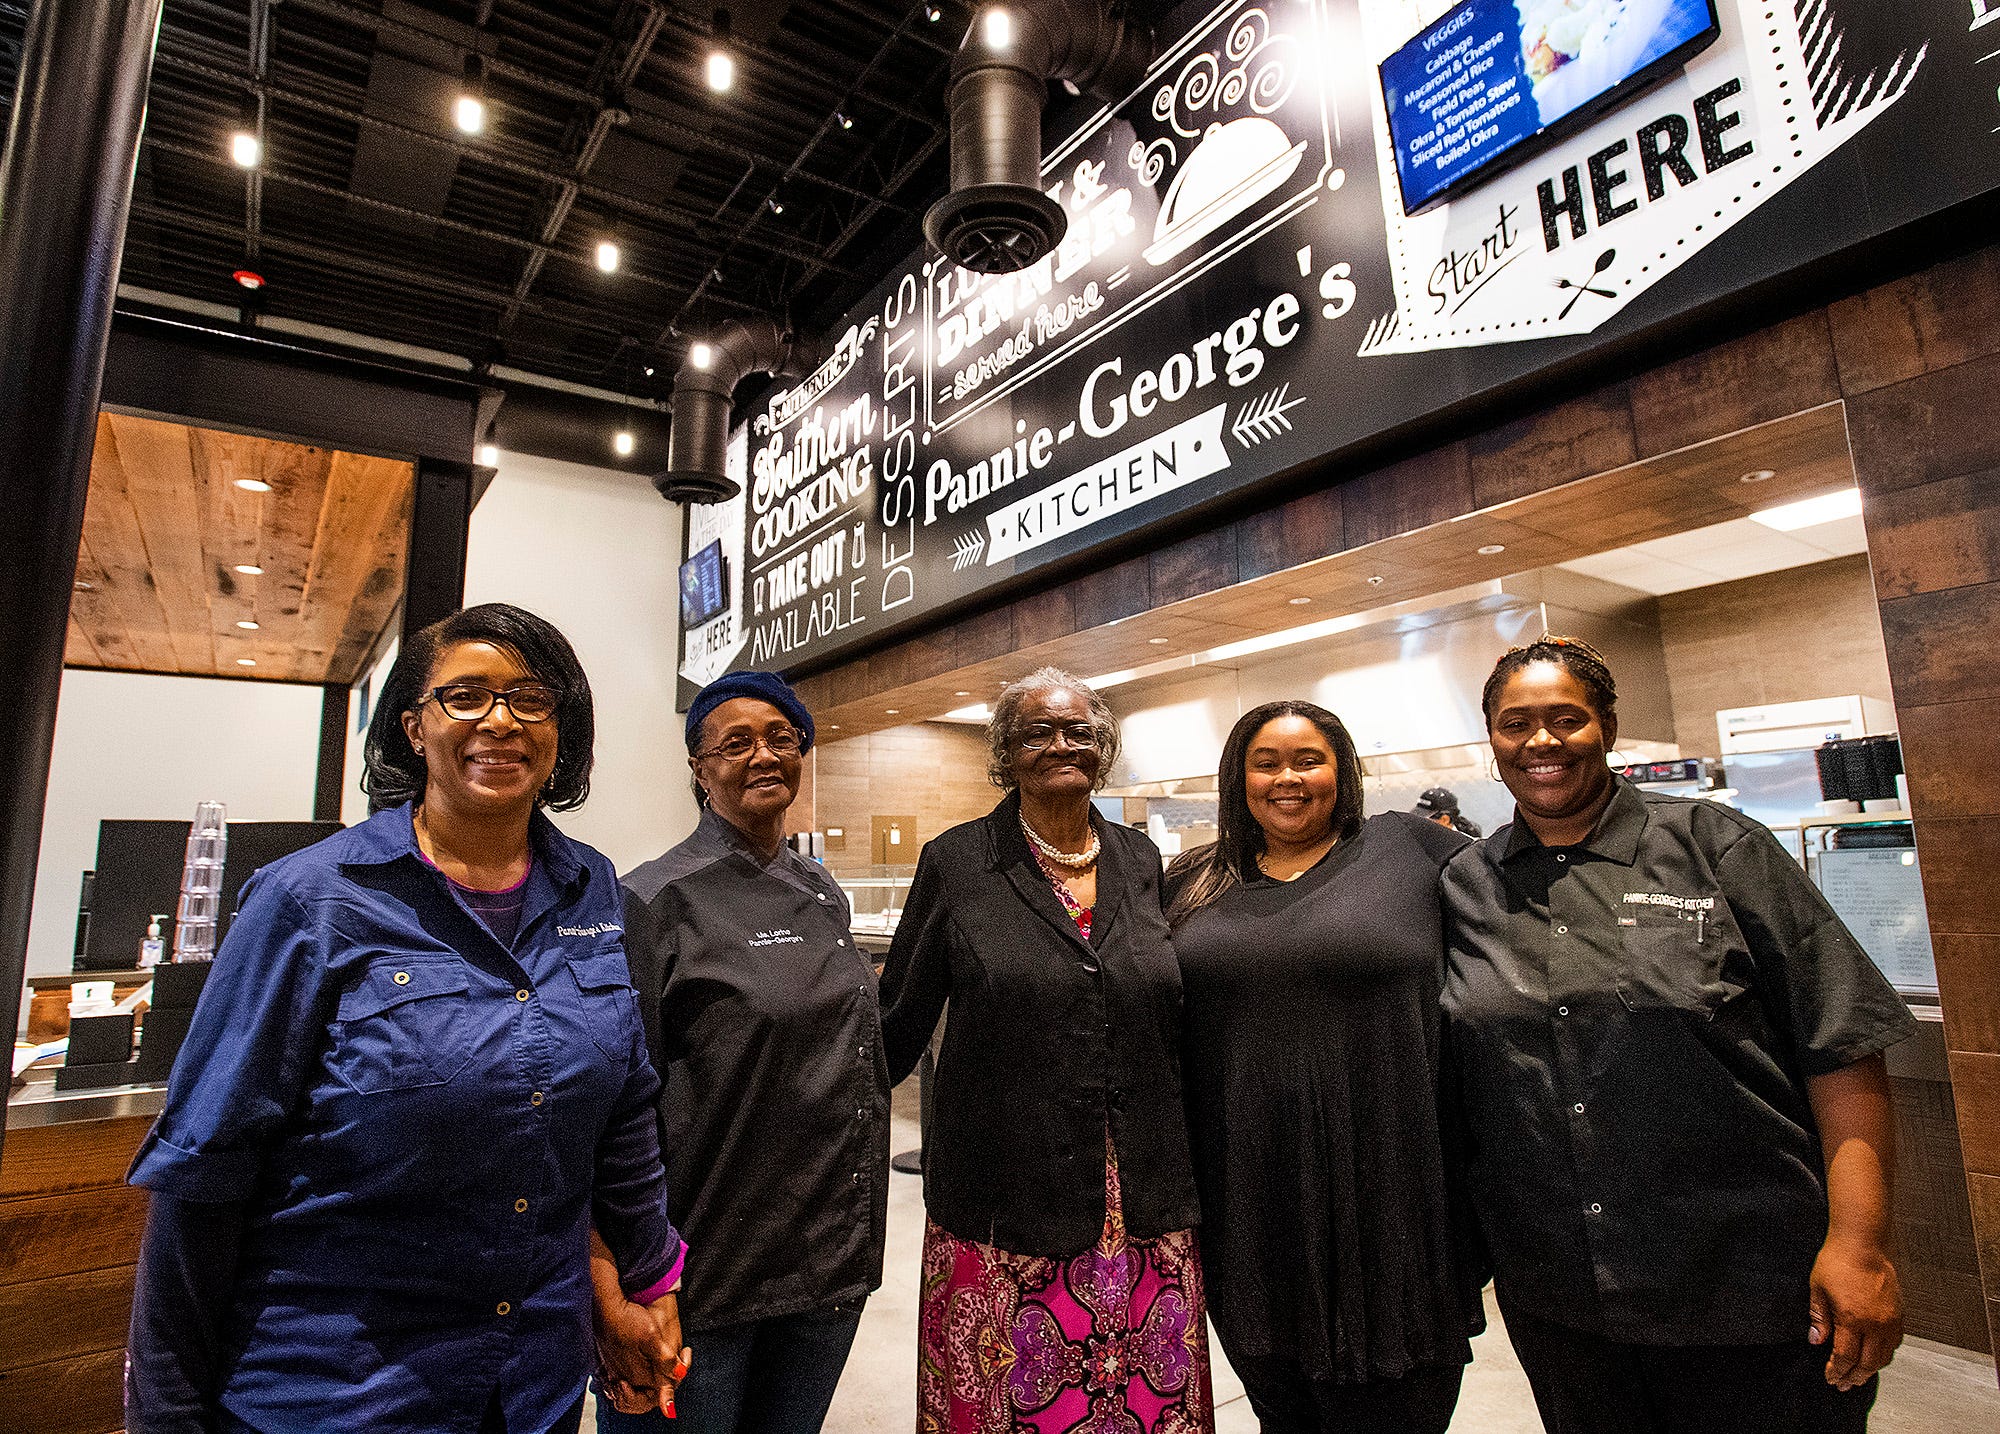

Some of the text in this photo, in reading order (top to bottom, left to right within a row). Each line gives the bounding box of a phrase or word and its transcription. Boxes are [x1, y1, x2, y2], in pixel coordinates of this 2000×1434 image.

[1404, 31, 1504, 107] Macaroni & Cheese
[1422, 6, 1475, 52] VEGGIES
[1425, 35, 1474, 75] Cabbage
[1409, 76, 1517, 153] Okra & Tomato Stew
[1418, 56, 1495, 115] Seasoned Rice
[1431, 79, 1486, 122] Field Peas
[1411, 142, 1444, 169] Sliced
[1443, 126, 1466, 149] Red
[1465, 92, 1521, 133] Tomatoes
[1435, 139, 1472, 170] Boiled
[1471, 124, 1499, 148] Okra
[1427, 203, 1519, 315] Start
[1536, 77, 1754, 253] HERE
[937, 187, 1136, 368] DINNER
[953, 281, 1105, 401] served here
[779, 354, 843, 422] AUTHENTIC
[923, 244, 1357, 527] Pannie-George's
[753, 392, 878, 515] Southern
[881, 272, 917, 612] DESSERTS
[751, 444, 874, 558] COOKING
[1016, 440, 1178, 543] KITCHEN
[767, 550, 808, 612] TAKE
[810, 529, 847, 590] OUT
[706, 615, 732, 656] HERE
[750, 576, 867, 667] AVAILABLE
